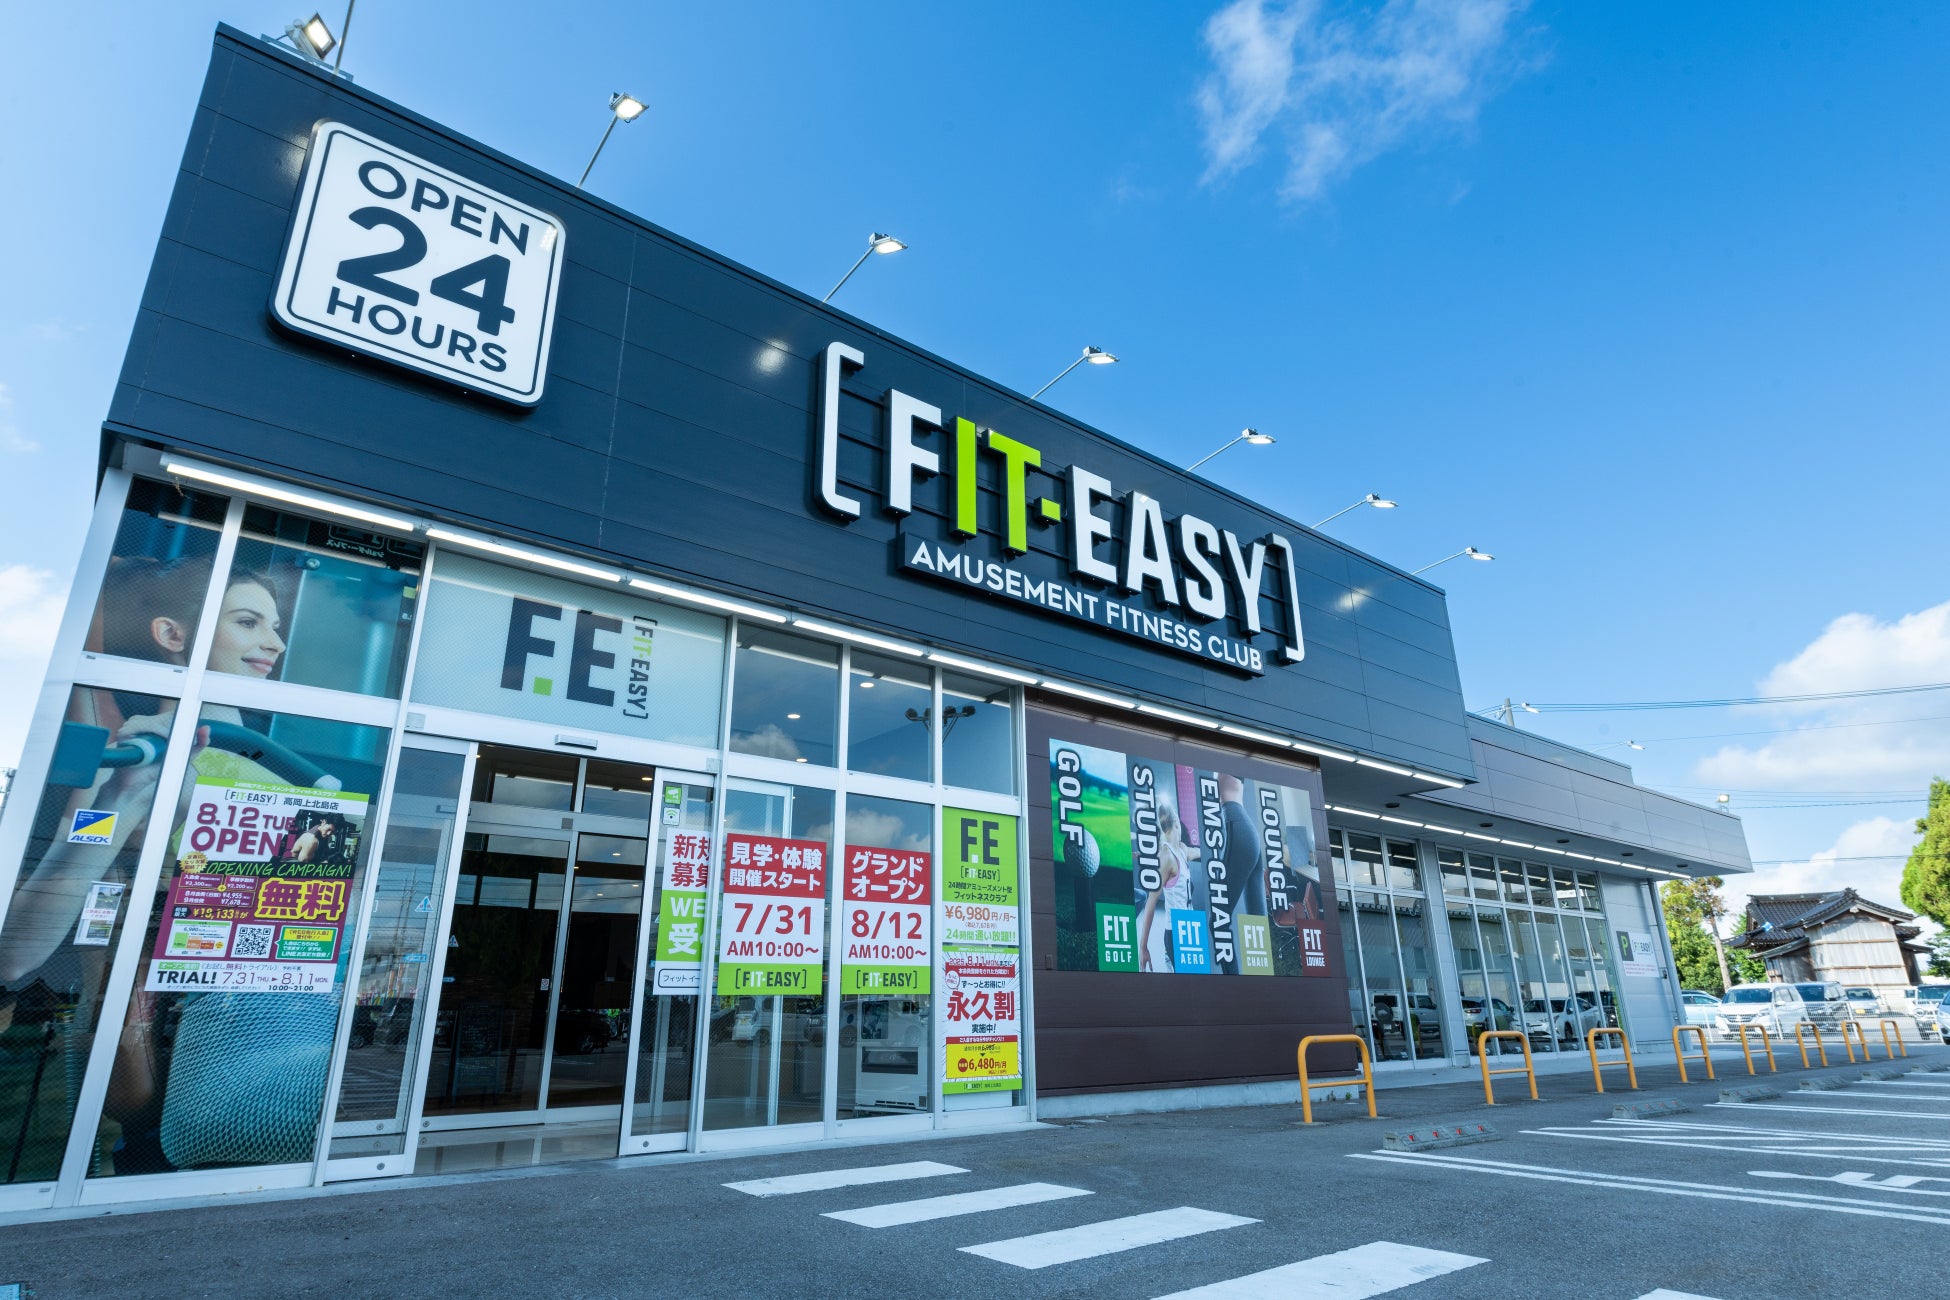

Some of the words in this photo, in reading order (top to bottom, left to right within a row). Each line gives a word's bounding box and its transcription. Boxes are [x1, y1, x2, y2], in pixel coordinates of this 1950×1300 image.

[358, 160, 530, 256] OPEN
[336, 206, 516, 337] 24
[326, 286, 507, 373] HOURS
[910, 540, 1099, 620] AMUSEMENT
[1106, 602, 1203, 651] FITNESS
[1207, 636, 1264, 671] CLUB
[1057, 750, 1084, 847] GOLF
[196, 802, 260, 829] 8.12
[1133, 765, 1161, 891] STUDIO
[70, 834, 109, 844] ALSOK
[190, 825, 298, 858] OPEN!
[1260, 790, 1289, 911] LOUNGE
[730, 841, 823, 871] 見学・体験
[852, 851, 924, 878] グランド
[206, 862, 275, 876] OPENING
[276, 863, 352, 878] CAMPAIGN!
[729, 868, 820, 892] 開催スタート
[1200, 778, 1234, 963] EMS-CHAIR
[257, 879, 343, 920] 無料
[851, 875, 924, 900] オープン
[954, 891, 1008, 903] フィットネスクラブ
[734, 902, 812, 935] 7/31
[851, 909, 922, 940] 8/12
[1103, 914, 1130, 942] FIT
[668, 923, 702, 955] 受
[1177, 920, 1201, 946] FIT
[1244, 925, 1265, 949] FIT
[1303, 928, 1322, 950] FIT
[1620, 935, 1629, 957] P
[1105, 950, 1132, 963] GOLF
[1180, 952, 1205, 965] AERO
[1246, 956, 1269, 968] CHAIR
[1305, 956, 1326, 967] LOUNGE
[157, 970, 217, 985] TRIAL!
[222, 972, 255, 985] 7.31
[281, 972, 314, 986] 8.11
[947, 990, 1016, 1022] 永久割
